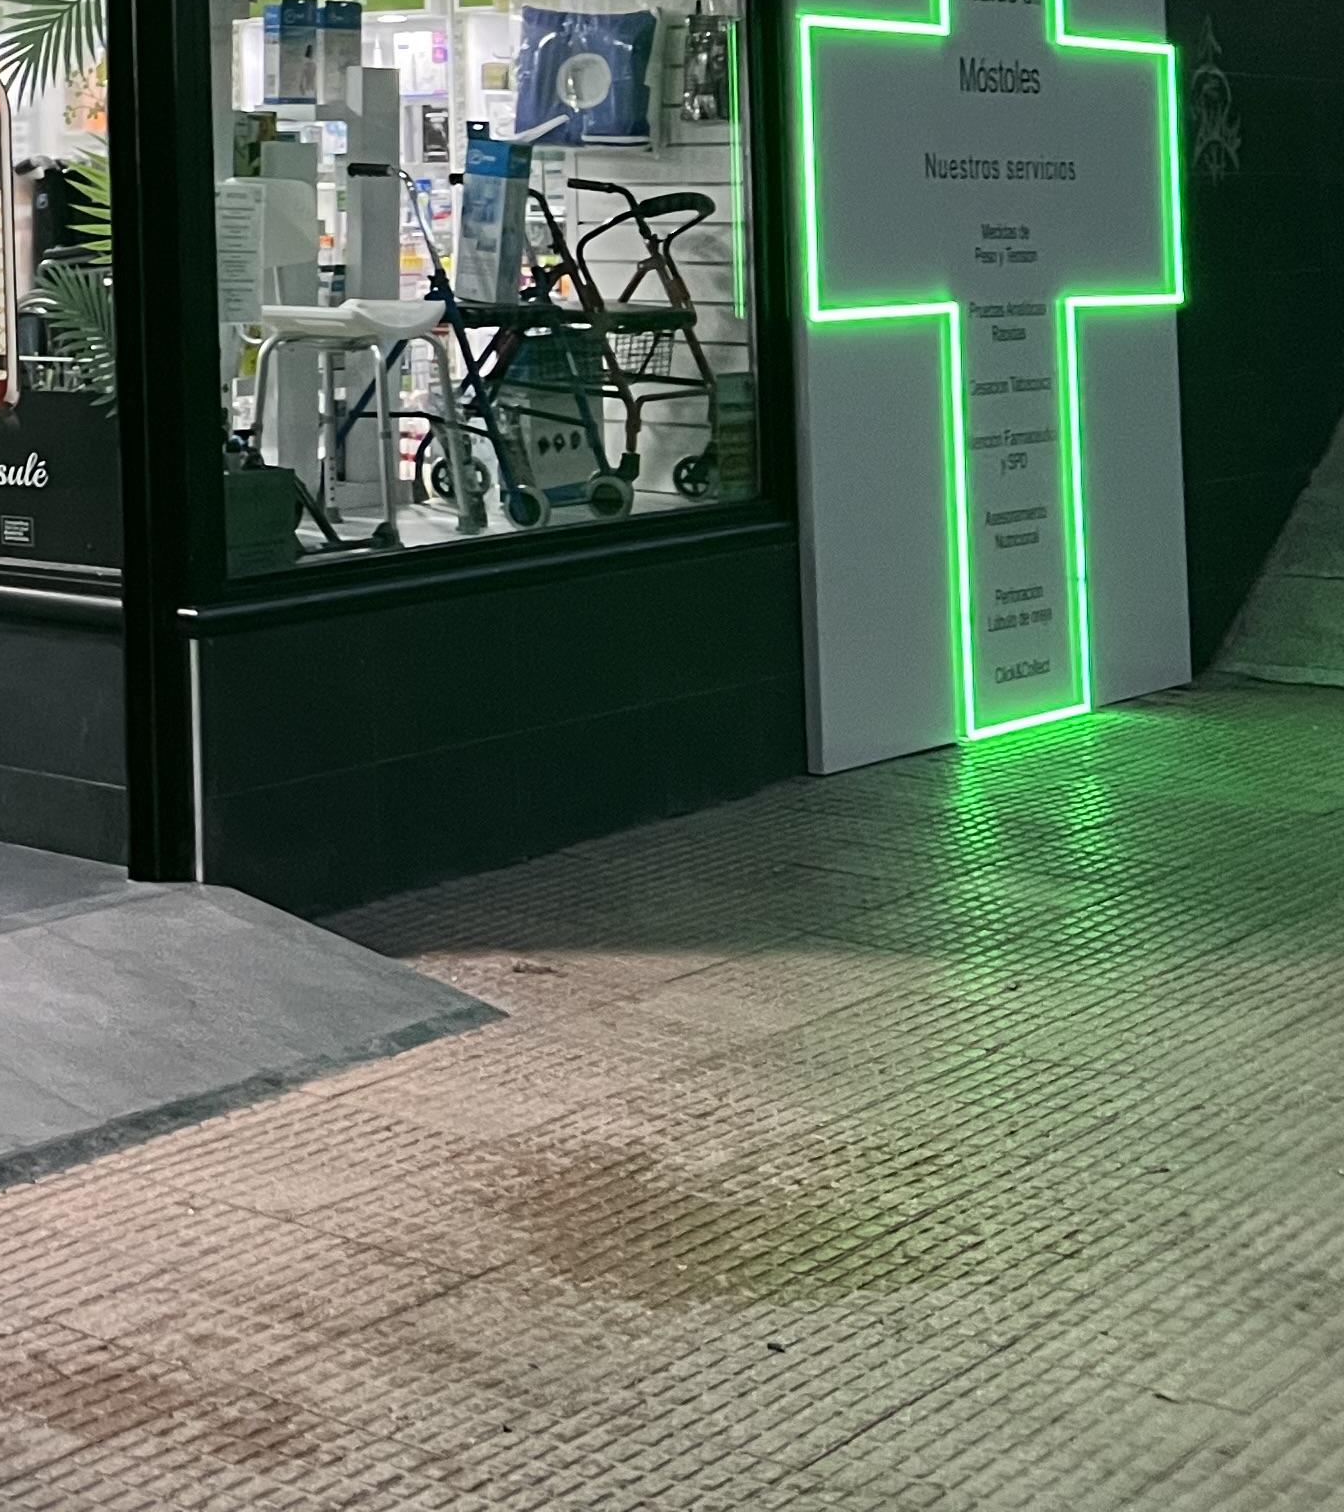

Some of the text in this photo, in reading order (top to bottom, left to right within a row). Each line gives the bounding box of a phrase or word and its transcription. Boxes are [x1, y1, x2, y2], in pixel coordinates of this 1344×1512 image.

[959, 56, 1042, 94] Móstoles
[924, 152, 1076, 181] Nuestros servicios
